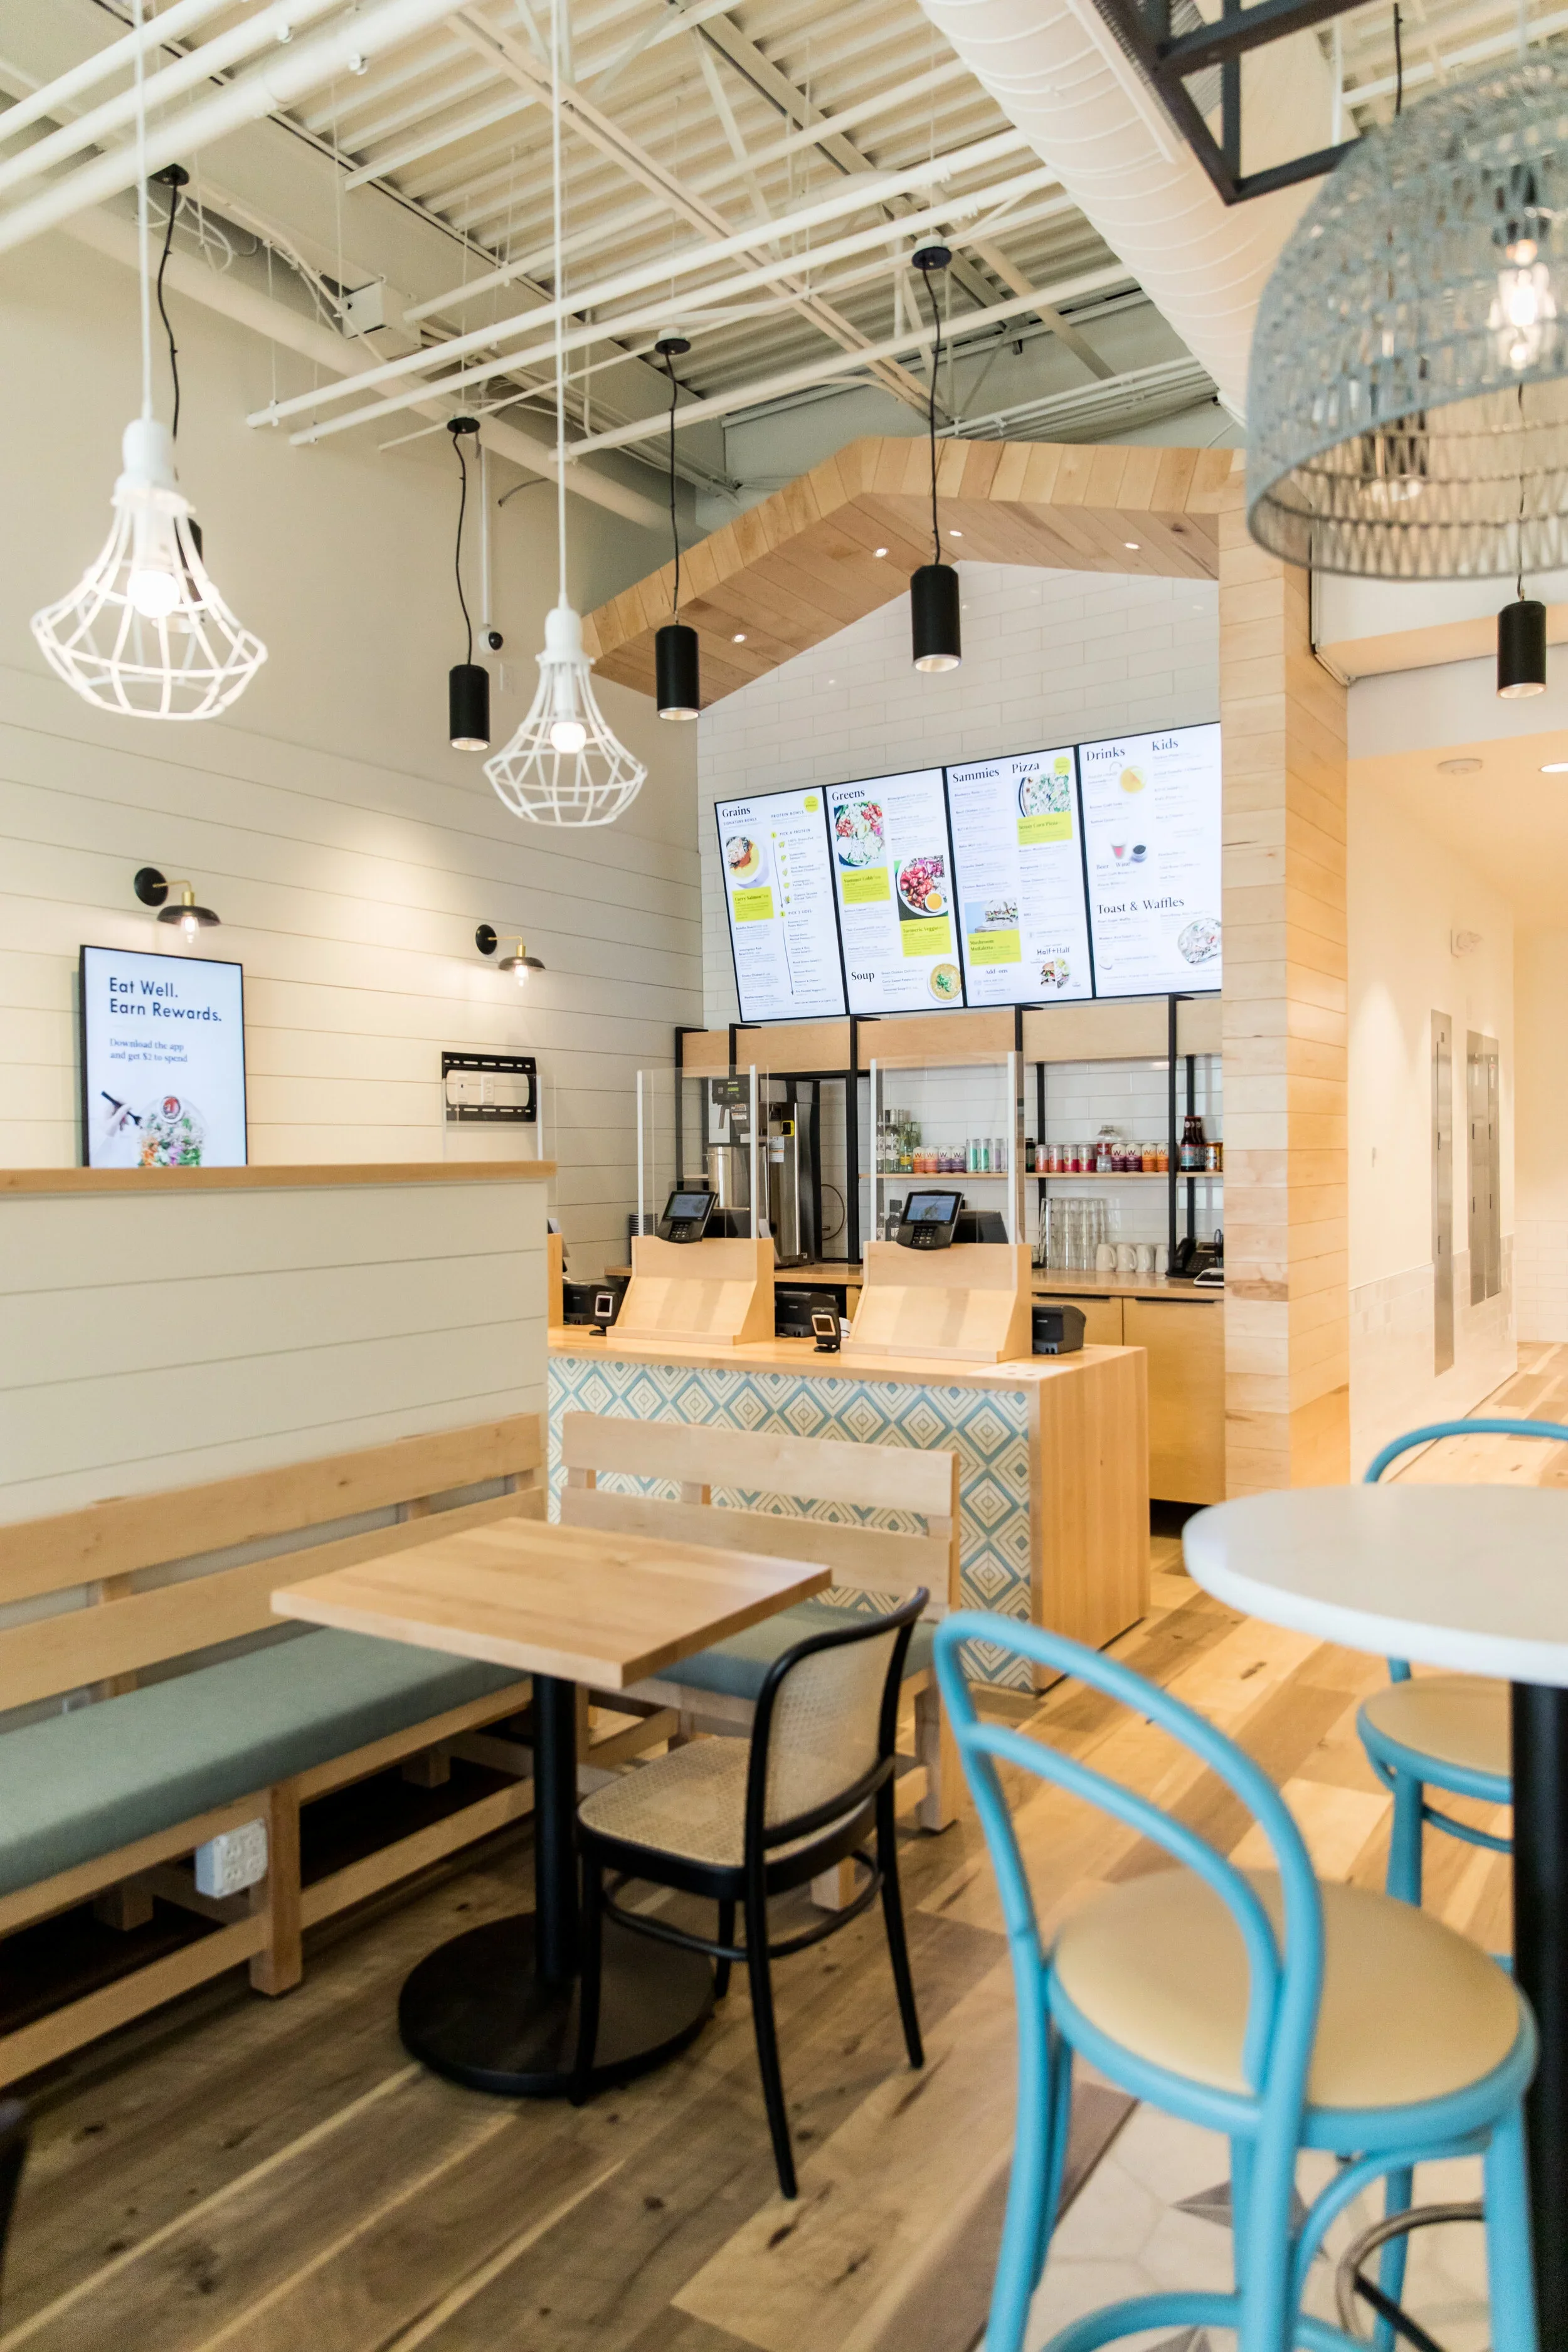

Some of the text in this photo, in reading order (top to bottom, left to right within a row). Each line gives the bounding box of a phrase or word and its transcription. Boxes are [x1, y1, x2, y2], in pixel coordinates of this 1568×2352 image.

[1152, 738, 1179, 751] Kids
[1087, 747, 1125, 761] Drinks
[1012, 762, 1039, 773] Pizza
[953, 768, 999, 782] Sammies
[832, 790, 865, 801] Greens
[722, 806, 751, 817] Grains
[1097, 897, 1184, 914] Toast & Waffles
[851, 972, 874, 982] Soup
[110, 977, 178, 997] Eat Well.
[110, 999, 222, 1022] Earn Rewards.
[110, 1038, 152, 1048] Download
[170, 1044, 184, 1052] app
[164, 1054, 188, 1063] spend
